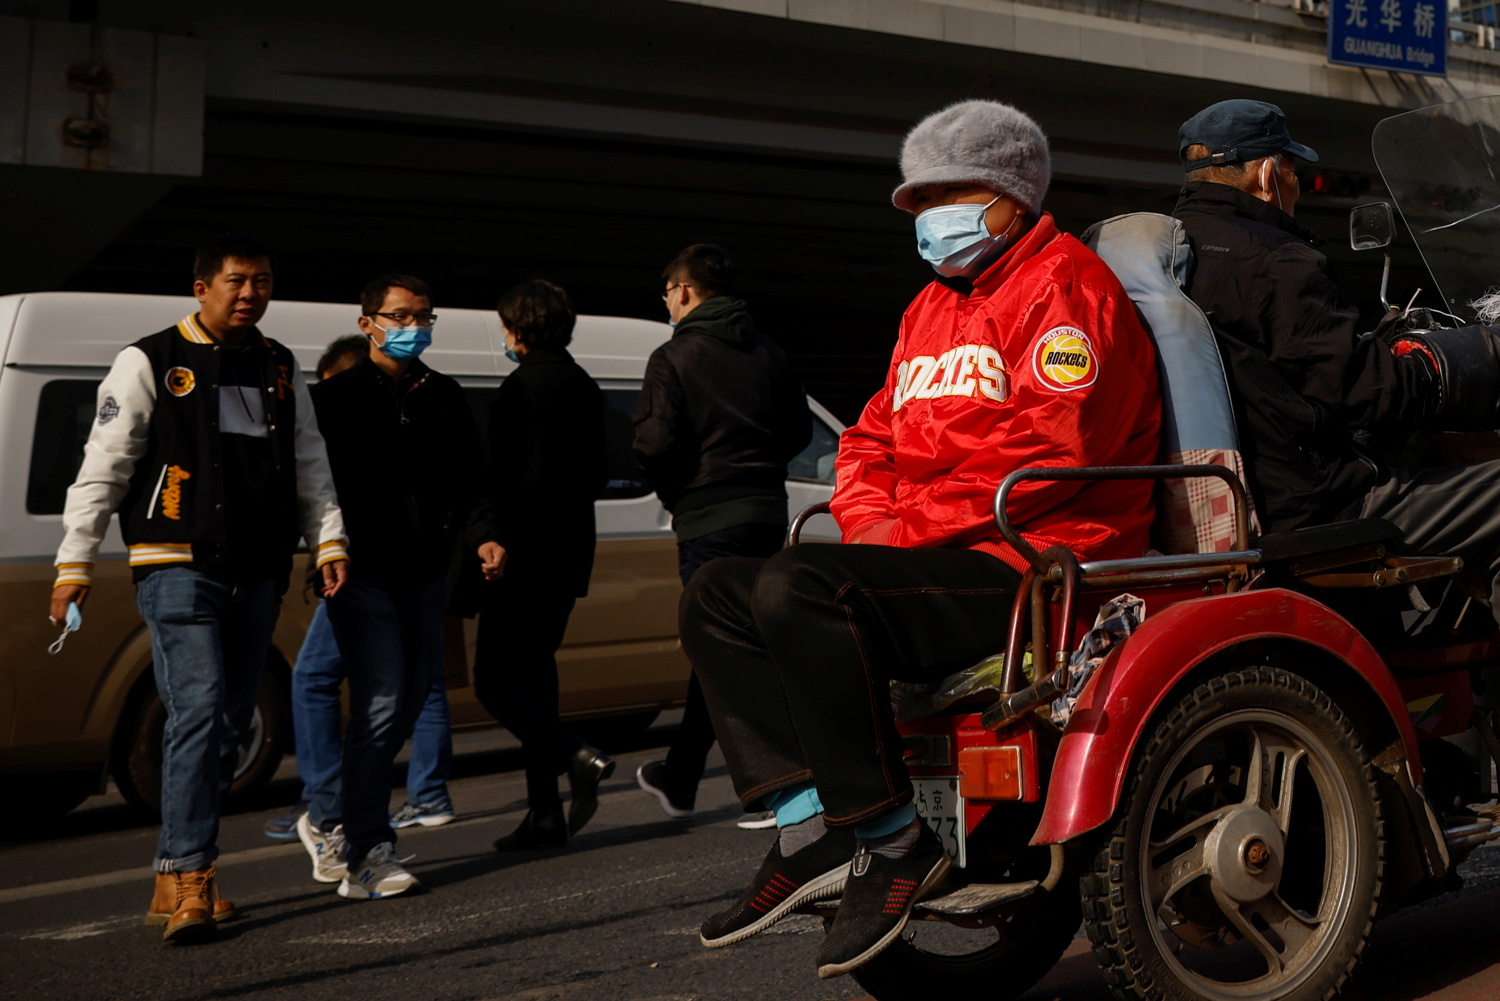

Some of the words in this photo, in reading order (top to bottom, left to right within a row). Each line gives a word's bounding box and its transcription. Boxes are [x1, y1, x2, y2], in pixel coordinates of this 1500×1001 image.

[1344, 37, 1403, 61] GUANGHUA
[1406, 45, 1435, 68] Bridge
[1043, 329, 1085, 344] HOUSTON
[932, 789, 943, 811] 京
